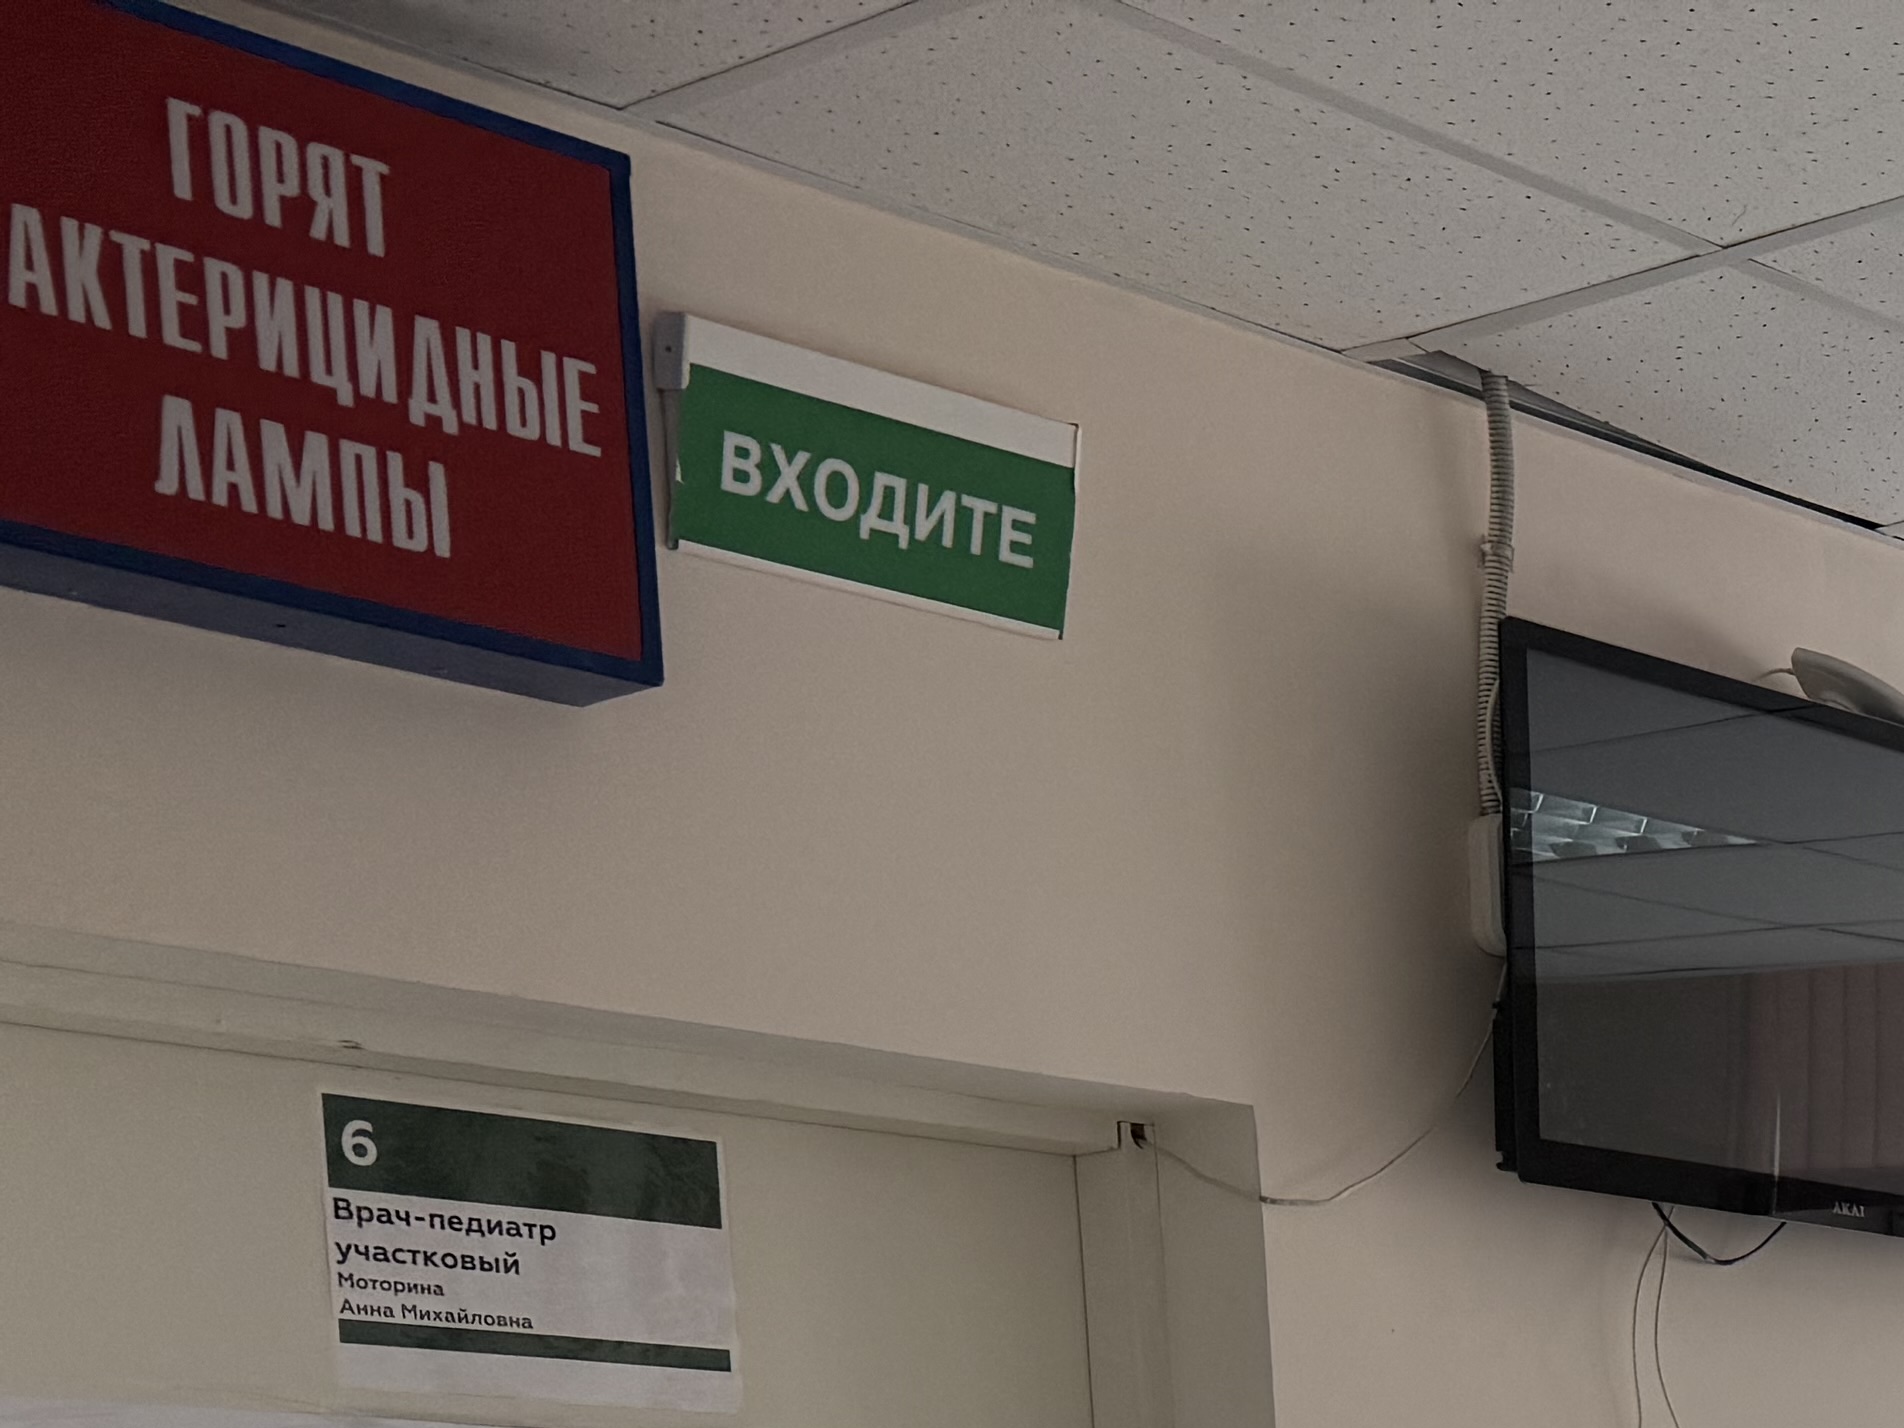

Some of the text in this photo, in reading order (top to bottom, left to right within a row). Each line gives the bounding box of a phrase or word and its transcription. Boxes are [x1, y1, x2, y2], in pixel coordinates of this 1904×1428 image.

[167, 97, 389, 258] ГОРЯТ
[154, 393, 452, 559] ЛАМПЫ
[719, 430, 1037, 572] ВХОДИТЕ
[340, 1120, 378, 1167] 6
[332, 1197, 557, 1246] Врач-педиатр
[1832, 1201, 1865, 1218] AKAI
[334, 1239, 520, 1276] участковый
[337, 1271, 445, 1297] Моторина
[339, 1299, 534, 1330] Анна Михайловна
